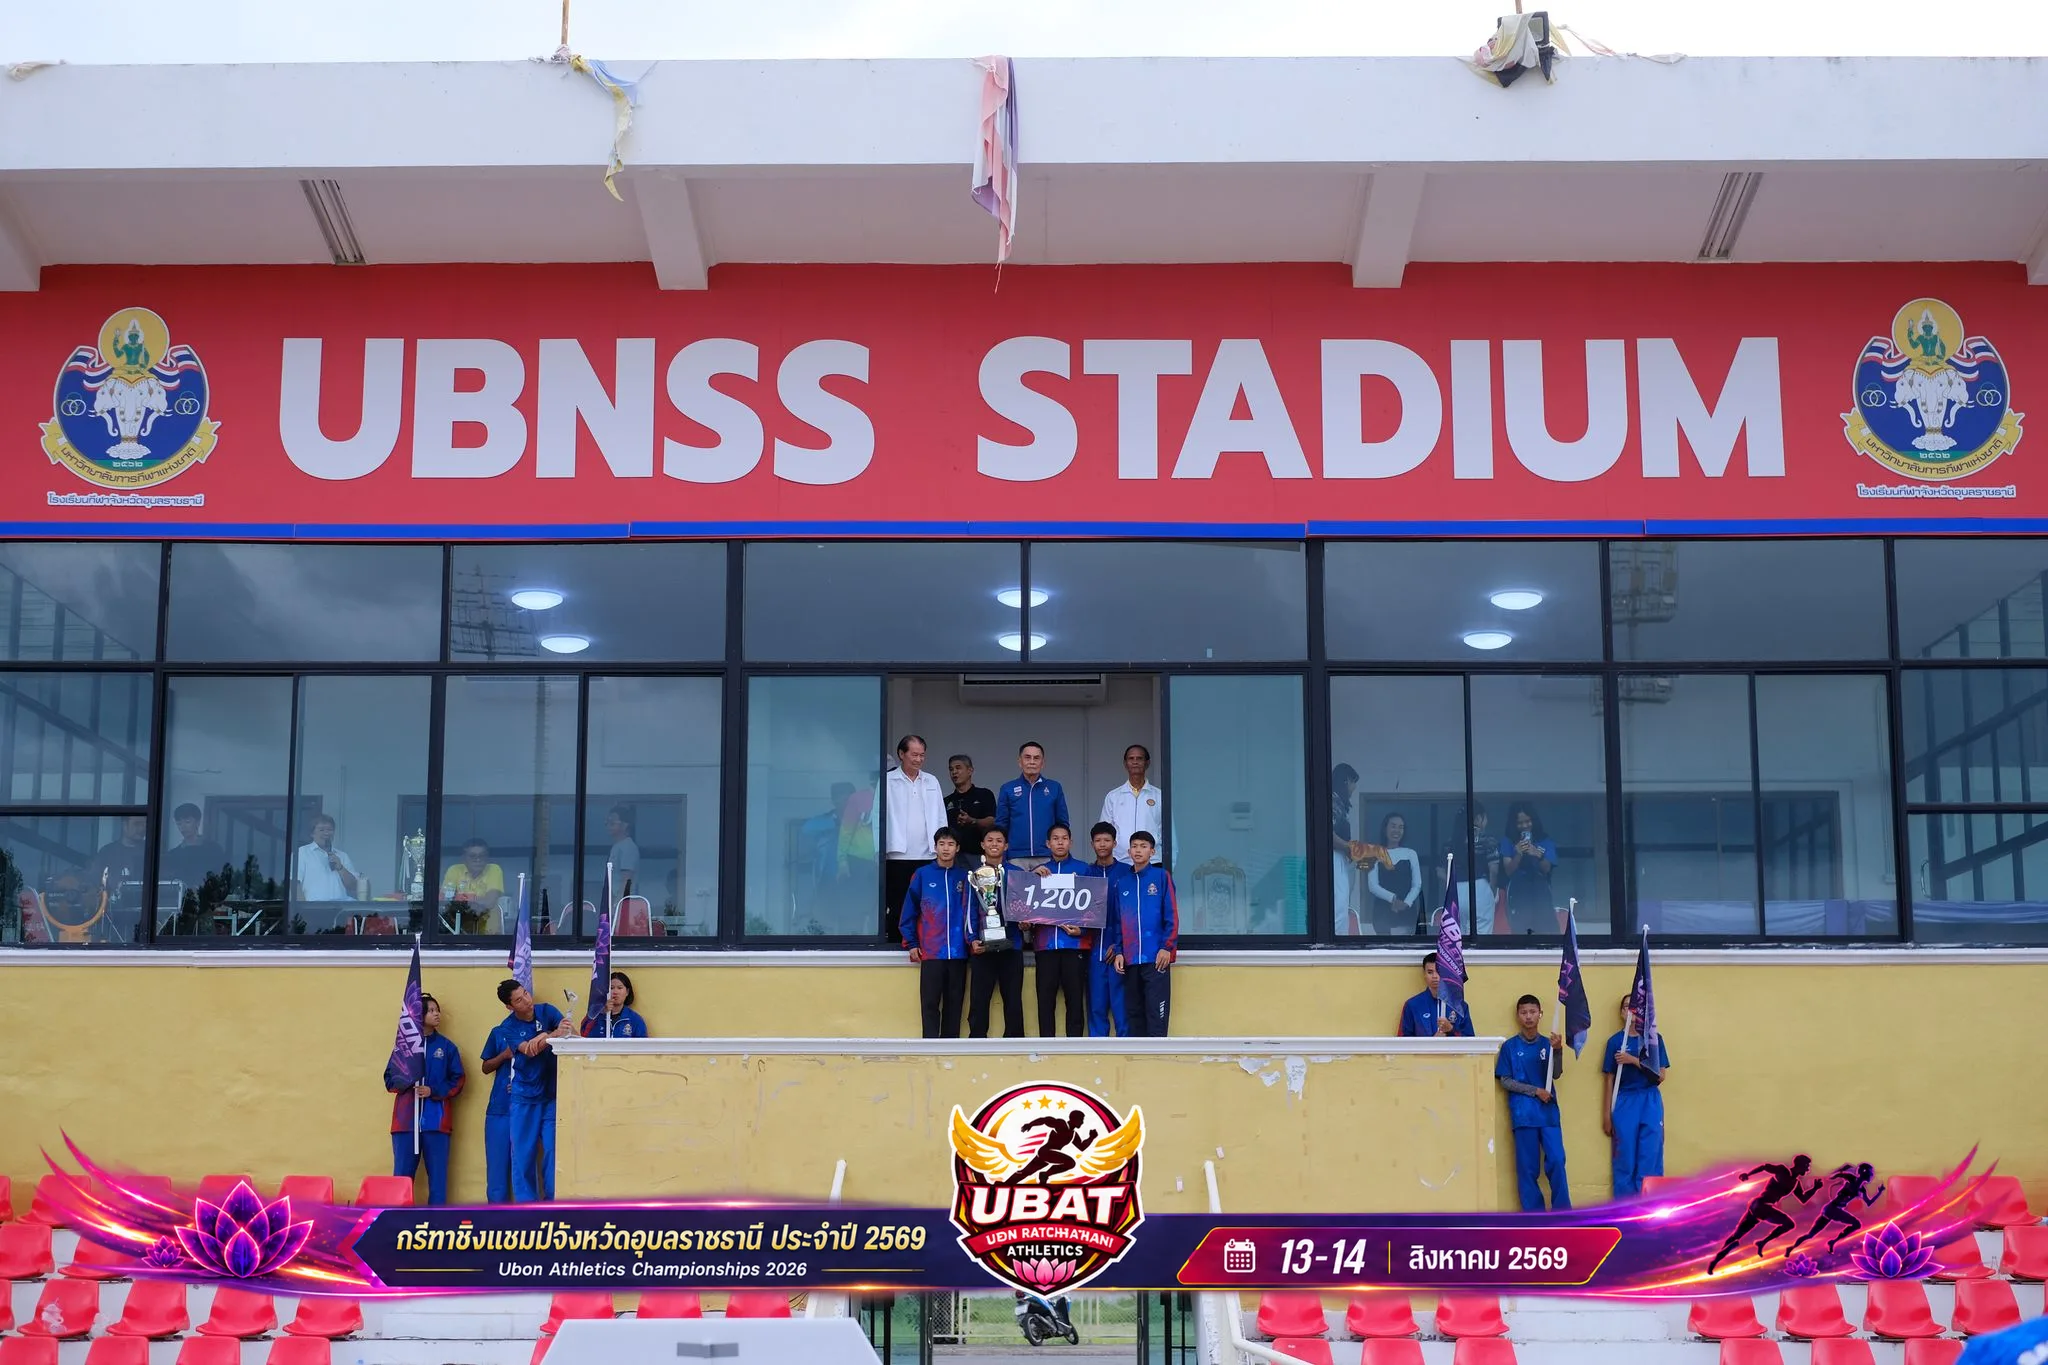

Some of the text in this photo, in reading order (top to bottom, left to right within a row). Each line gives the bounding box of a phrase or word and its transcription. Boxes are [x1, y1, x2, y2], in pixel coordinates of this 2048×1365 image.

[279, 336, 1786, 486] UBNSS STADIUM
[61, 447, 197, 483] มหาวิทยาลัยการกีฬาแห่งชาติ
[1865, 438, 2003, 475] มหาวิทยาลัยการกีฬาแห่งชาติ
[1024, 884, 1092, 911] 1,200
